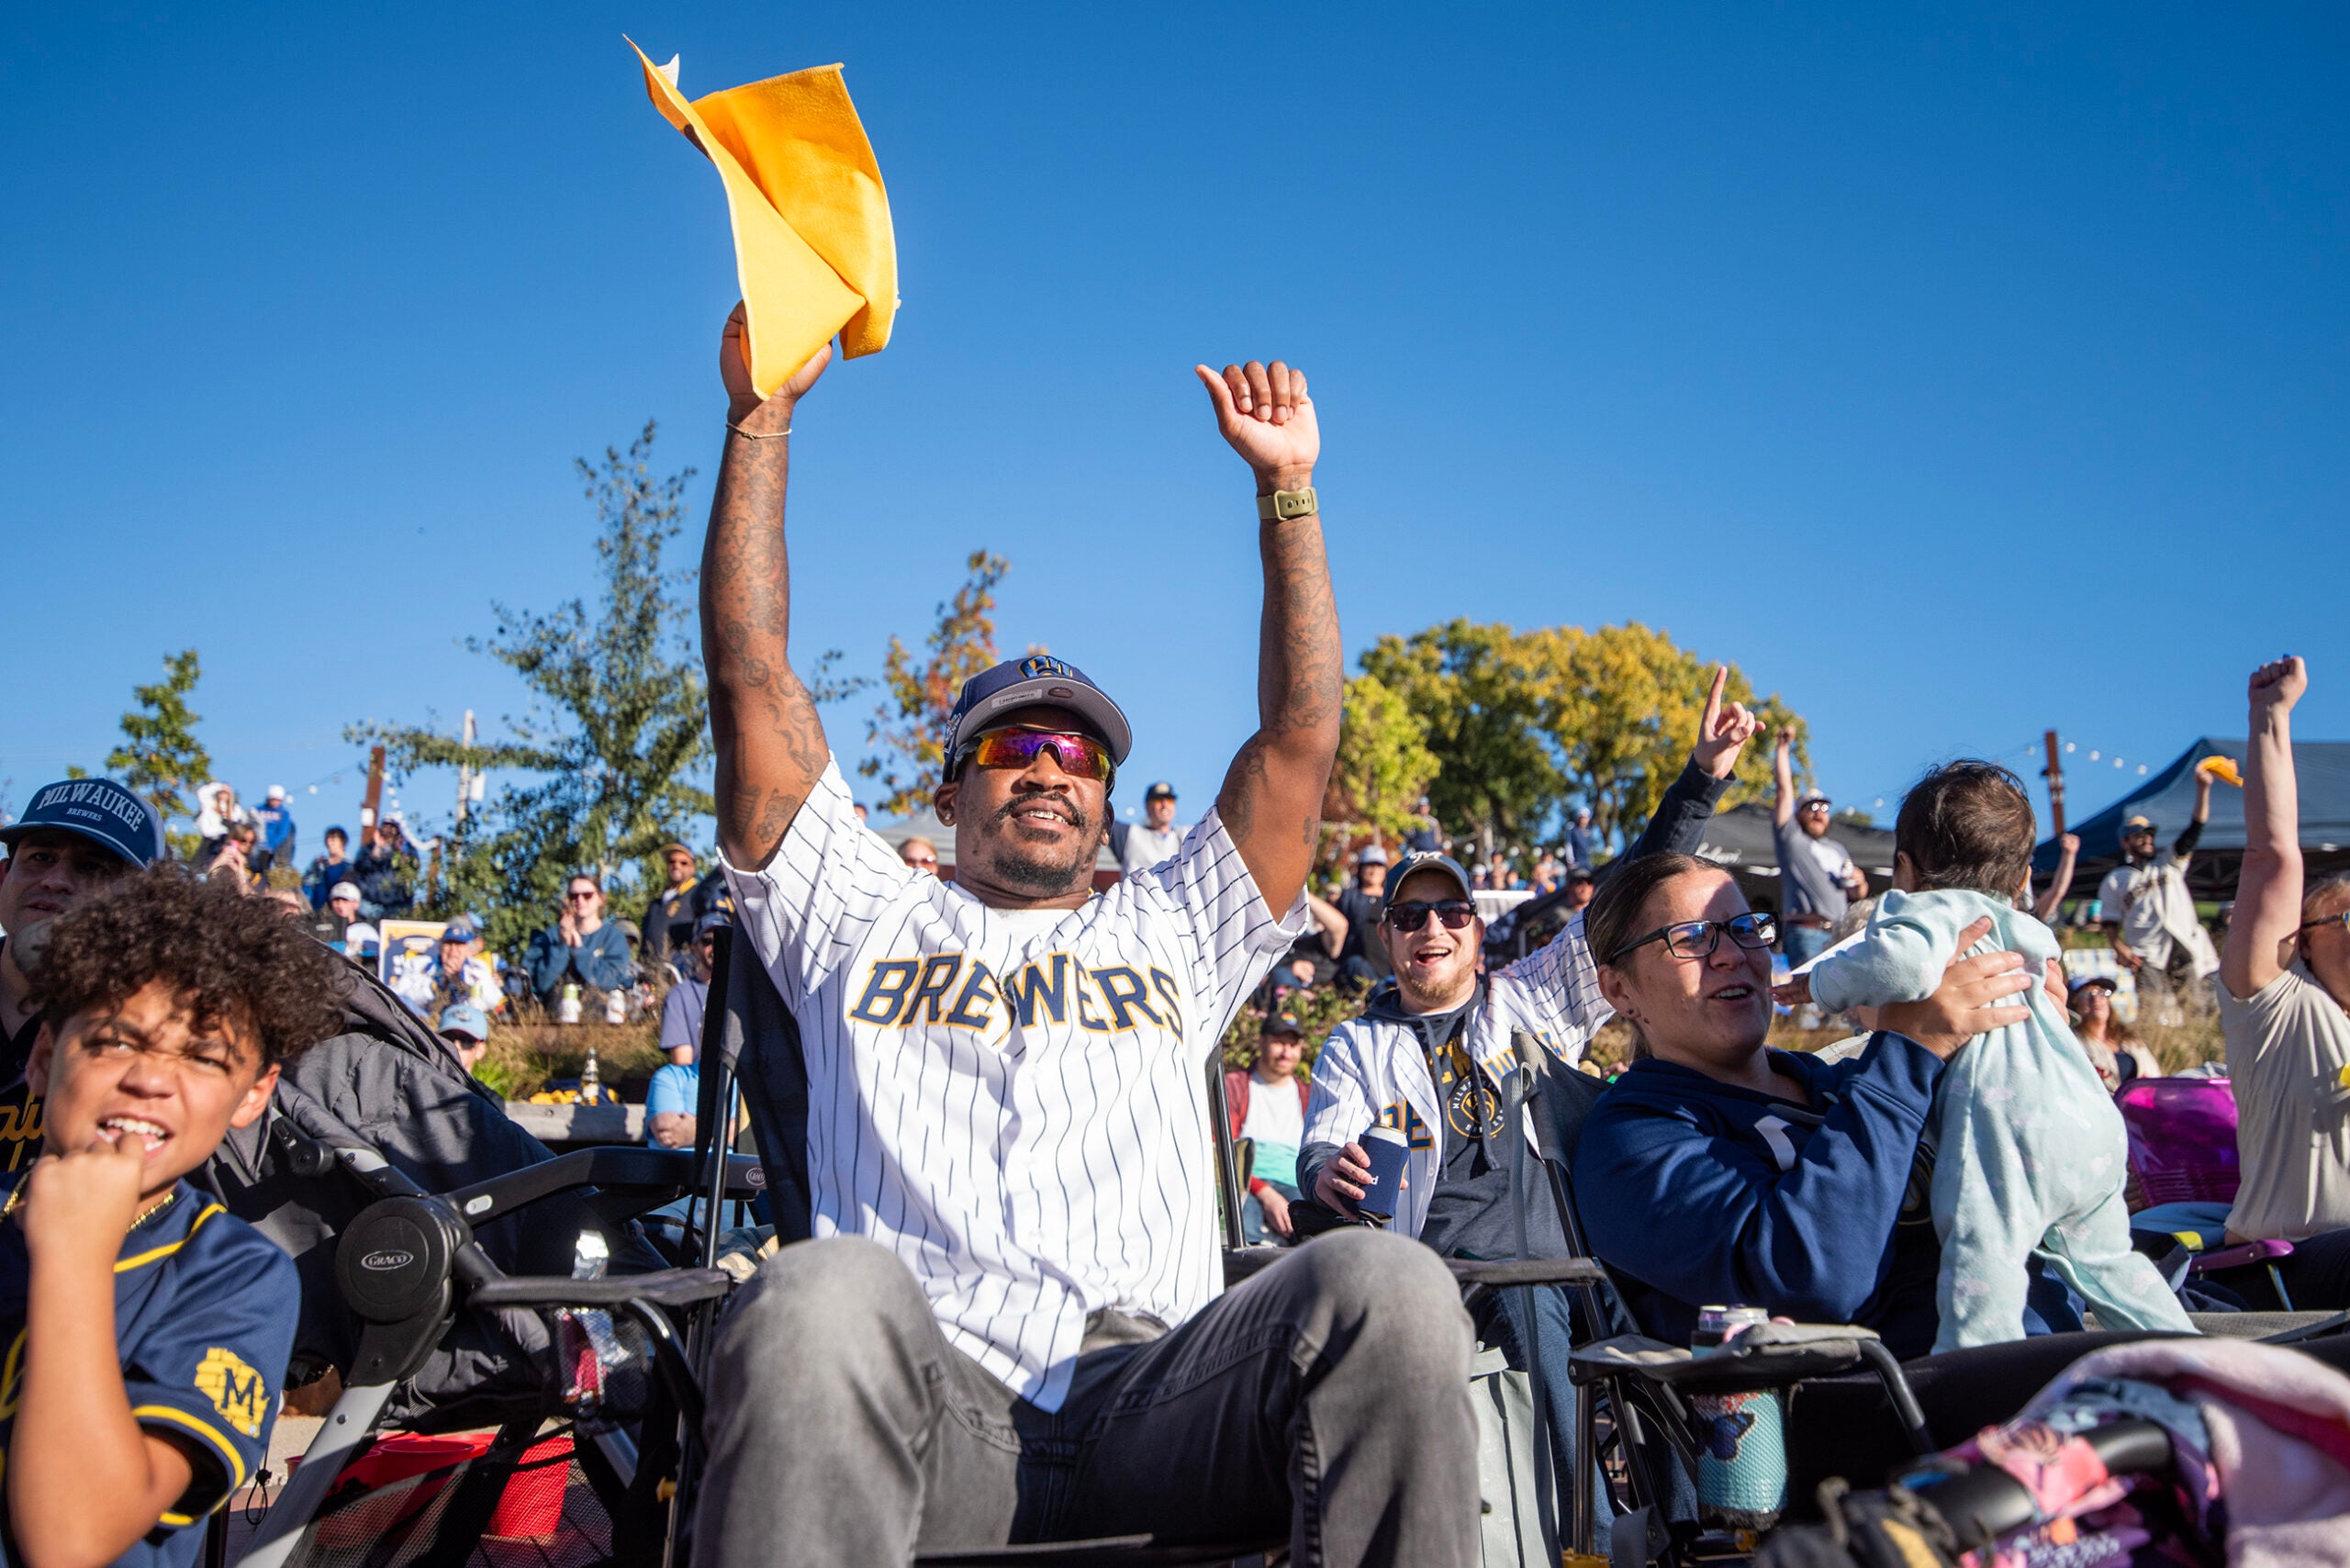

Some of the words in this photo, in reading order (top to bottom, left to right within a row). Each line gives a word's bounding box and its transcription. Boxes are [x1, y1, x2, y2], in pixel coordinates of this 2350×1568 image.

[36, 783, 146, 833] MILWAUKEE
[66, 807, 103, 822] BREWERS
[845, 951, 1183, 1046] BREWERS
[221, 1367, 257, 1417] M
